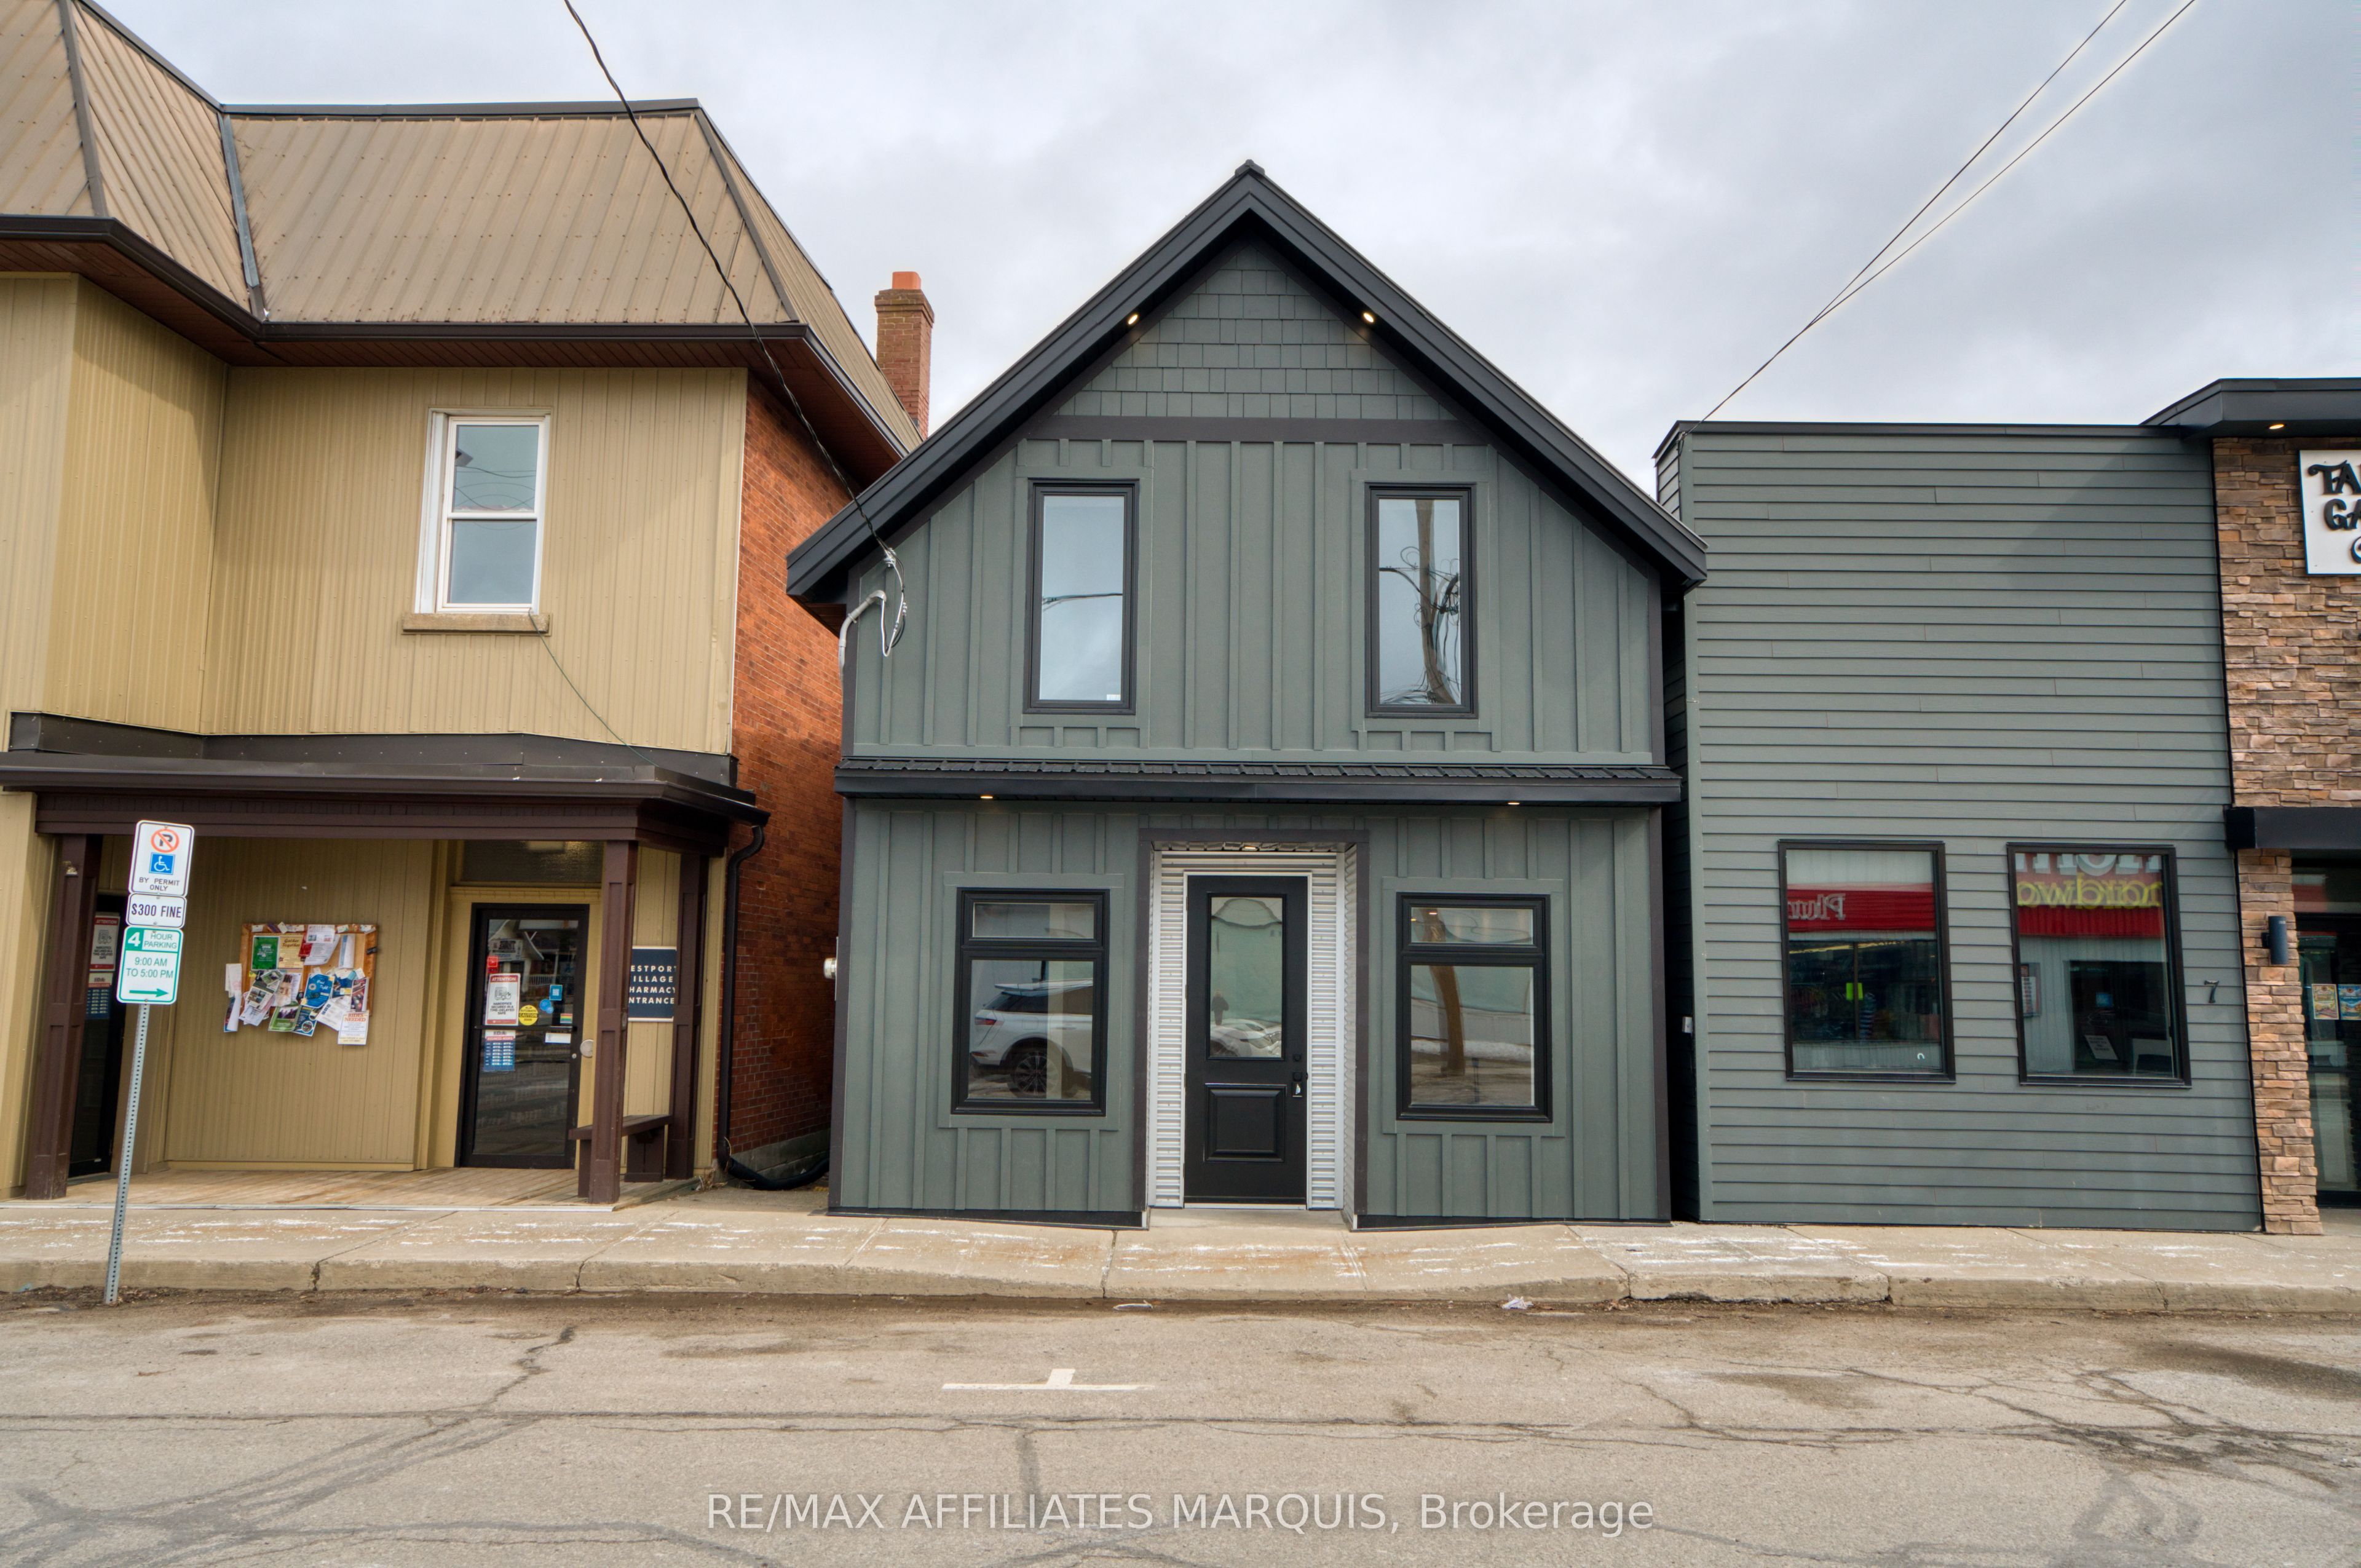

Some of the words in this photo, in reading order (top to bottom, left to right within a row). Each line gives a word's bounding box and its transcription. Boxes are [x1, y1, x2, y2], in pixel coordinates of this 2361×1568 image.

[2308, 460, 2361, 495] TA
[131, 903, 157, 916] $300
[160, 905, 182, 918] FINE
[127, 932, 141, 947] 4
[135, 957, 152, 966] 9:00
[153, 958, 168, 967] AM
[126, 968, 138, 977] TO
[140, 969, 158, 978] 5:00
[160, 970, 173, 978] PM
[2204, 980, 2220, 1004] 7
